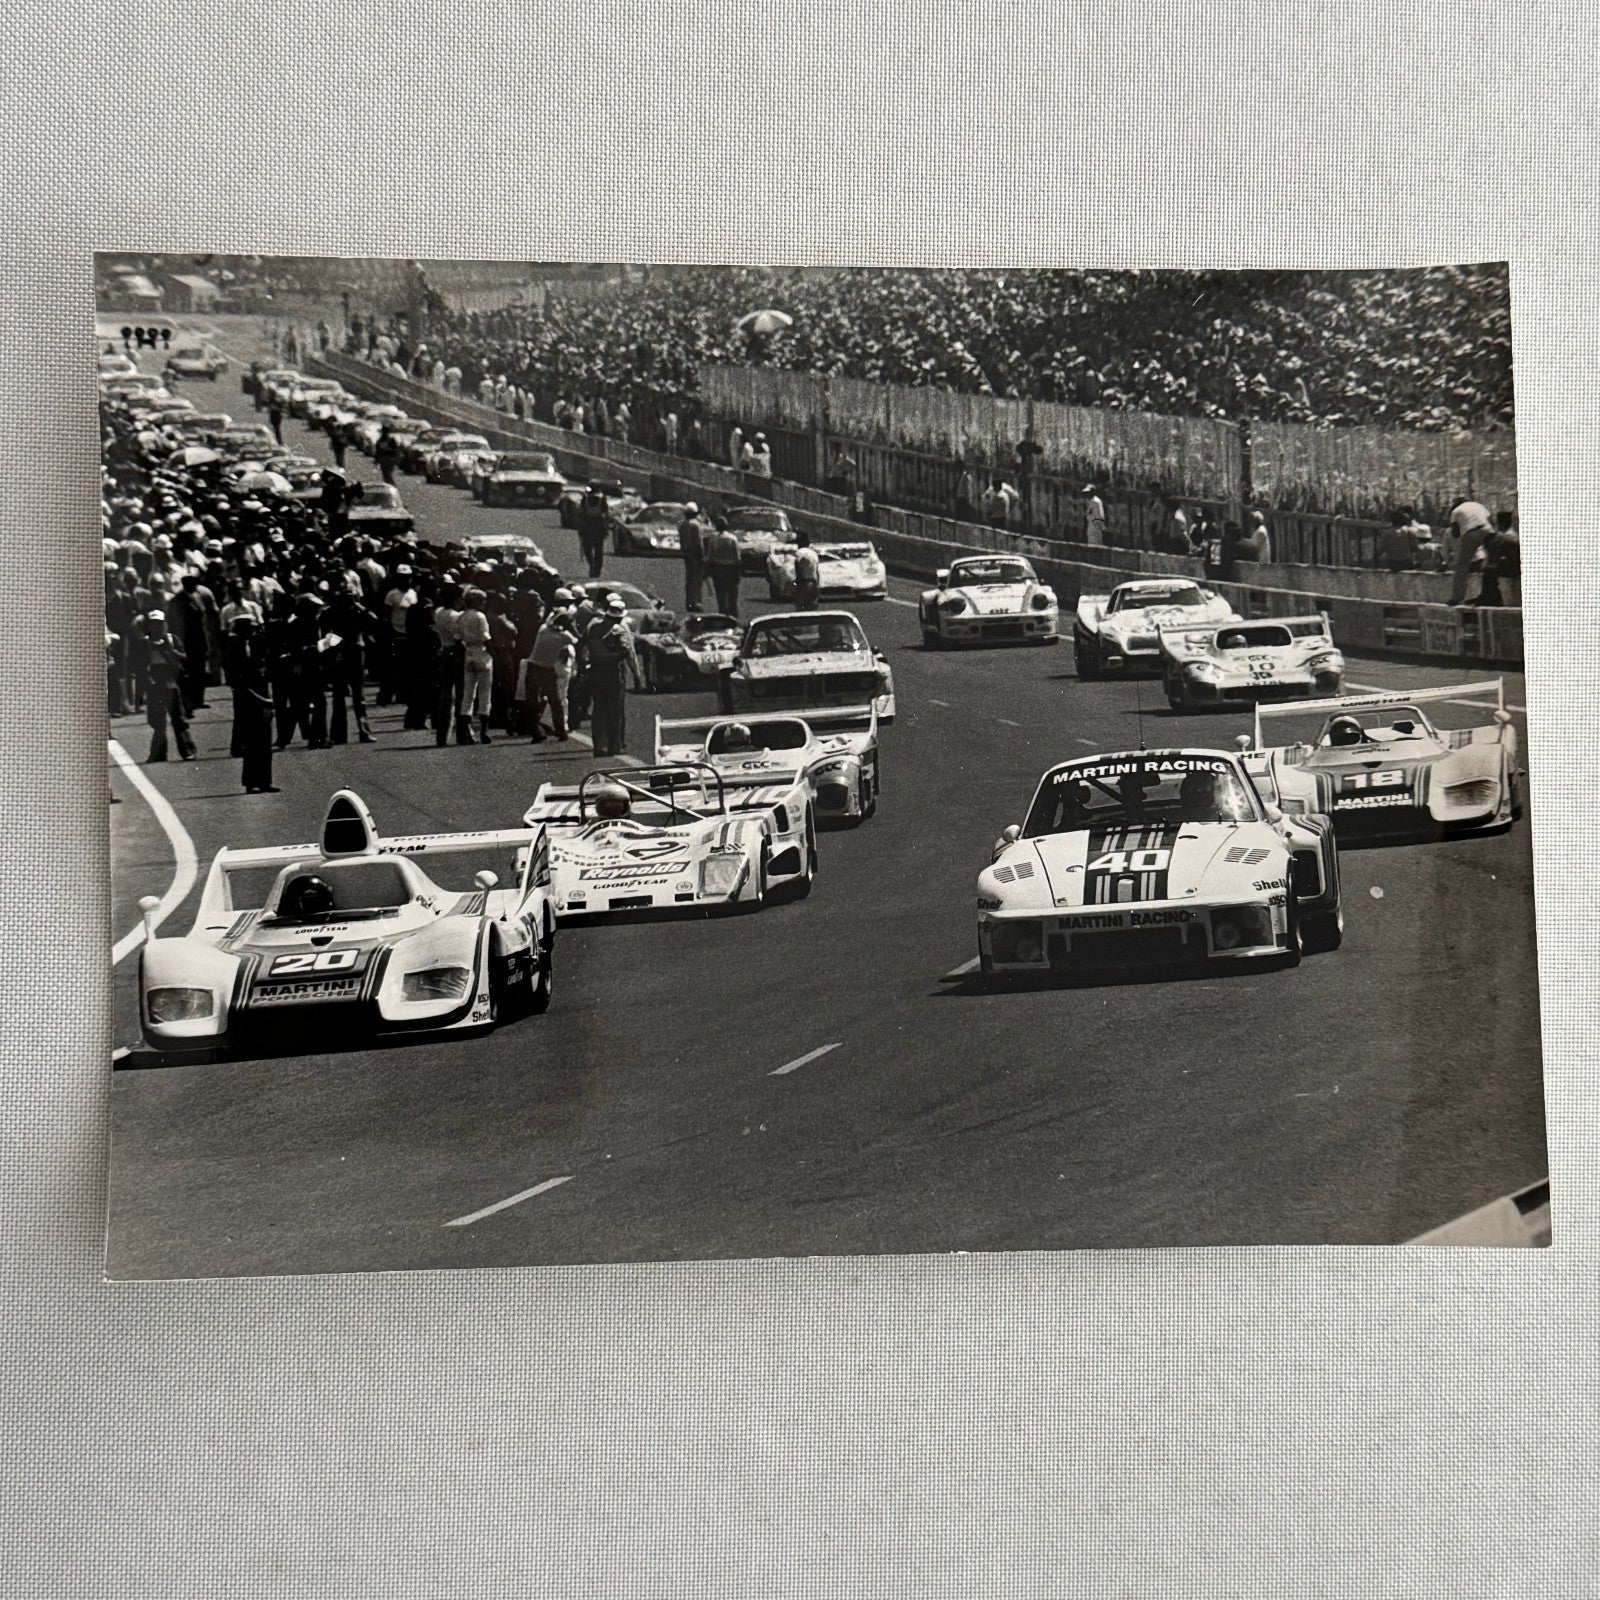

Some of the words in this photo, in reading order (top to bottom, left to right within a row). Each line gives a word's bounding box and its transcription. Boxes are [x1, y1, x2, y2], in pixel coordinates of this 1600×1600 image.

[1053, 762, 1138, 785] MARTINI
[1144, 760, 1227, 773] RACING
[1344, 770, 1404, 789] 18
[1337, 793, 1410, 806] MARTINI
[626, 841, 687, 861] 2
[582, 862, 685, 879] Reynolds
[1087, 849, 1171, 874] 40
[1252, 878, 1287, 891] Shell
[1058, 914, 1123, 930] MARTINI
[1130, 910, 1192, 926] RACING
[270, 949, 360, 976] 20
[253, 989, 358, 1003] PORSCHE
[260, 980, 355, 997] MARTINI
